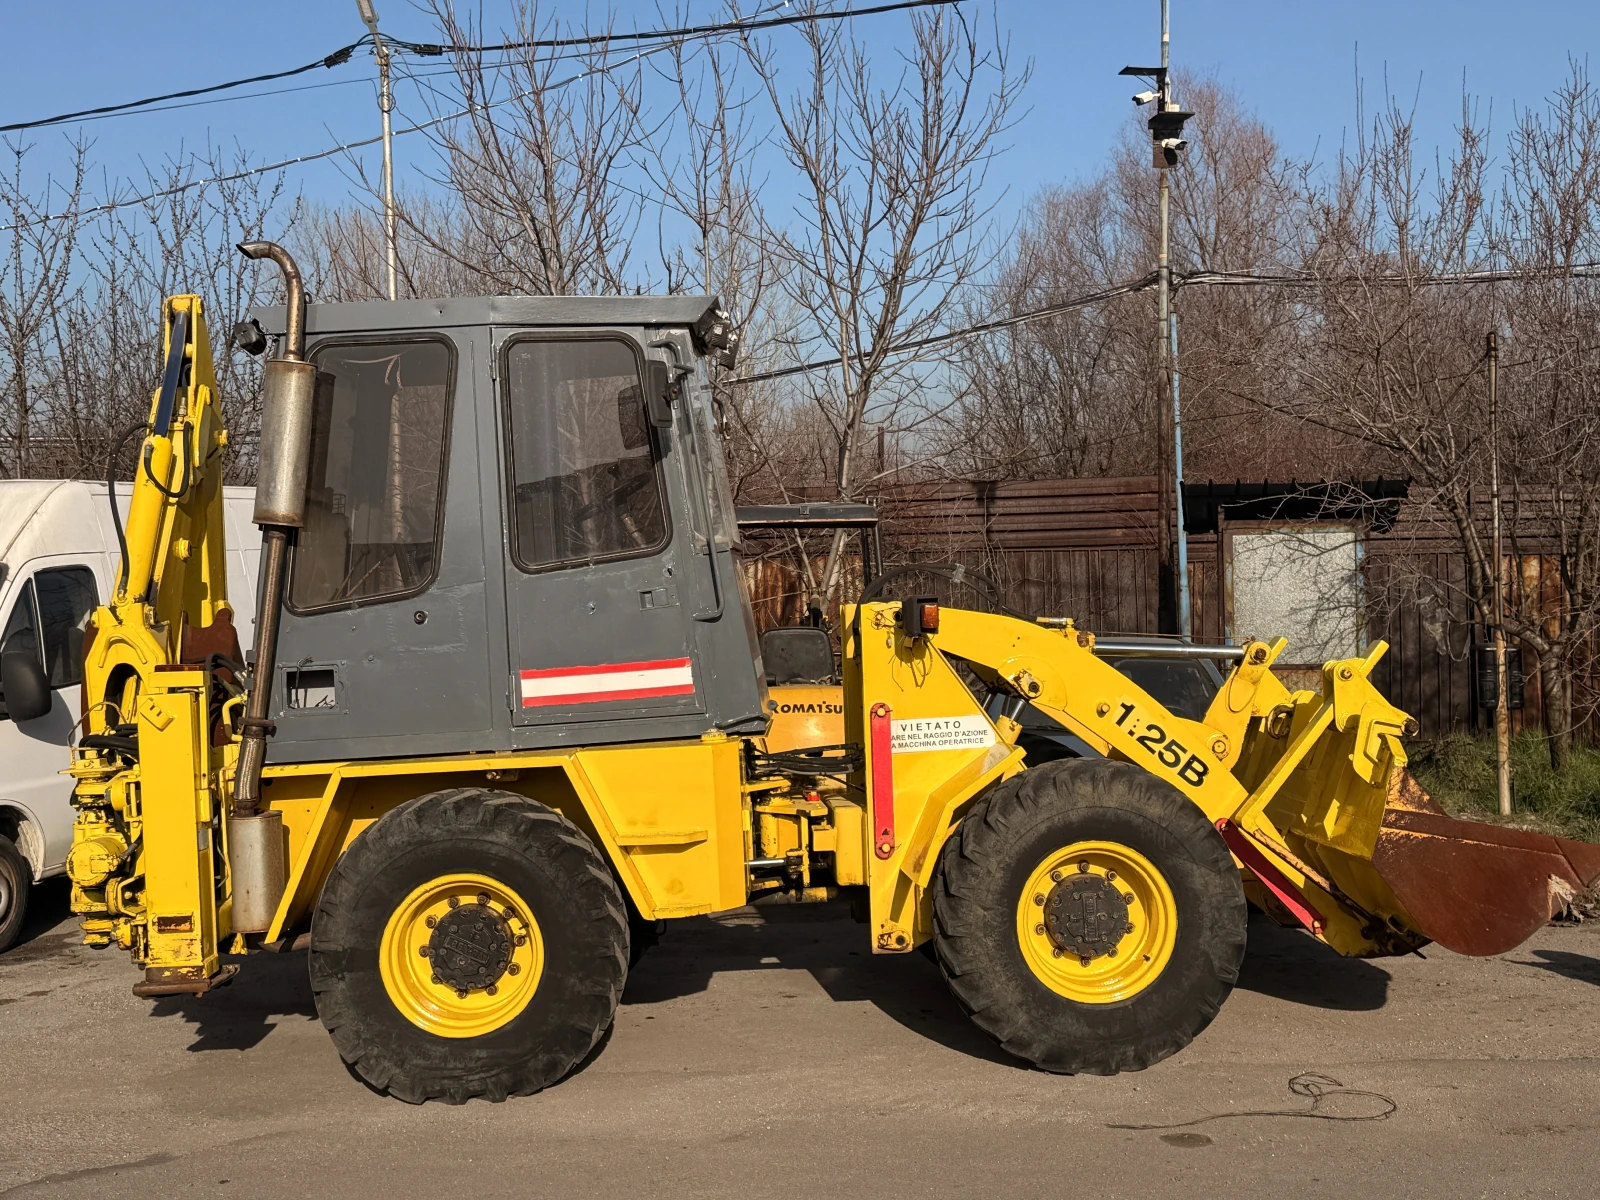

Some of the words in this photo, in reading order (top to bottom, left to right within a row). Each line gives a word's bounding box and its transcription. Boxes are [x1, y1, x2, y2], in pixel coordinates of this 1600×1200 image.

[900, 720, 961, 732] VIETATO
[907, 732, 922, 740] NEL
[923, 731, 953, 739] RAGGIO
[954, 729, 988, 738] D'AZIONE
[898, 740, 937, 748] MACCHINA
[938, 737, 985, 746] OPERATRICE
